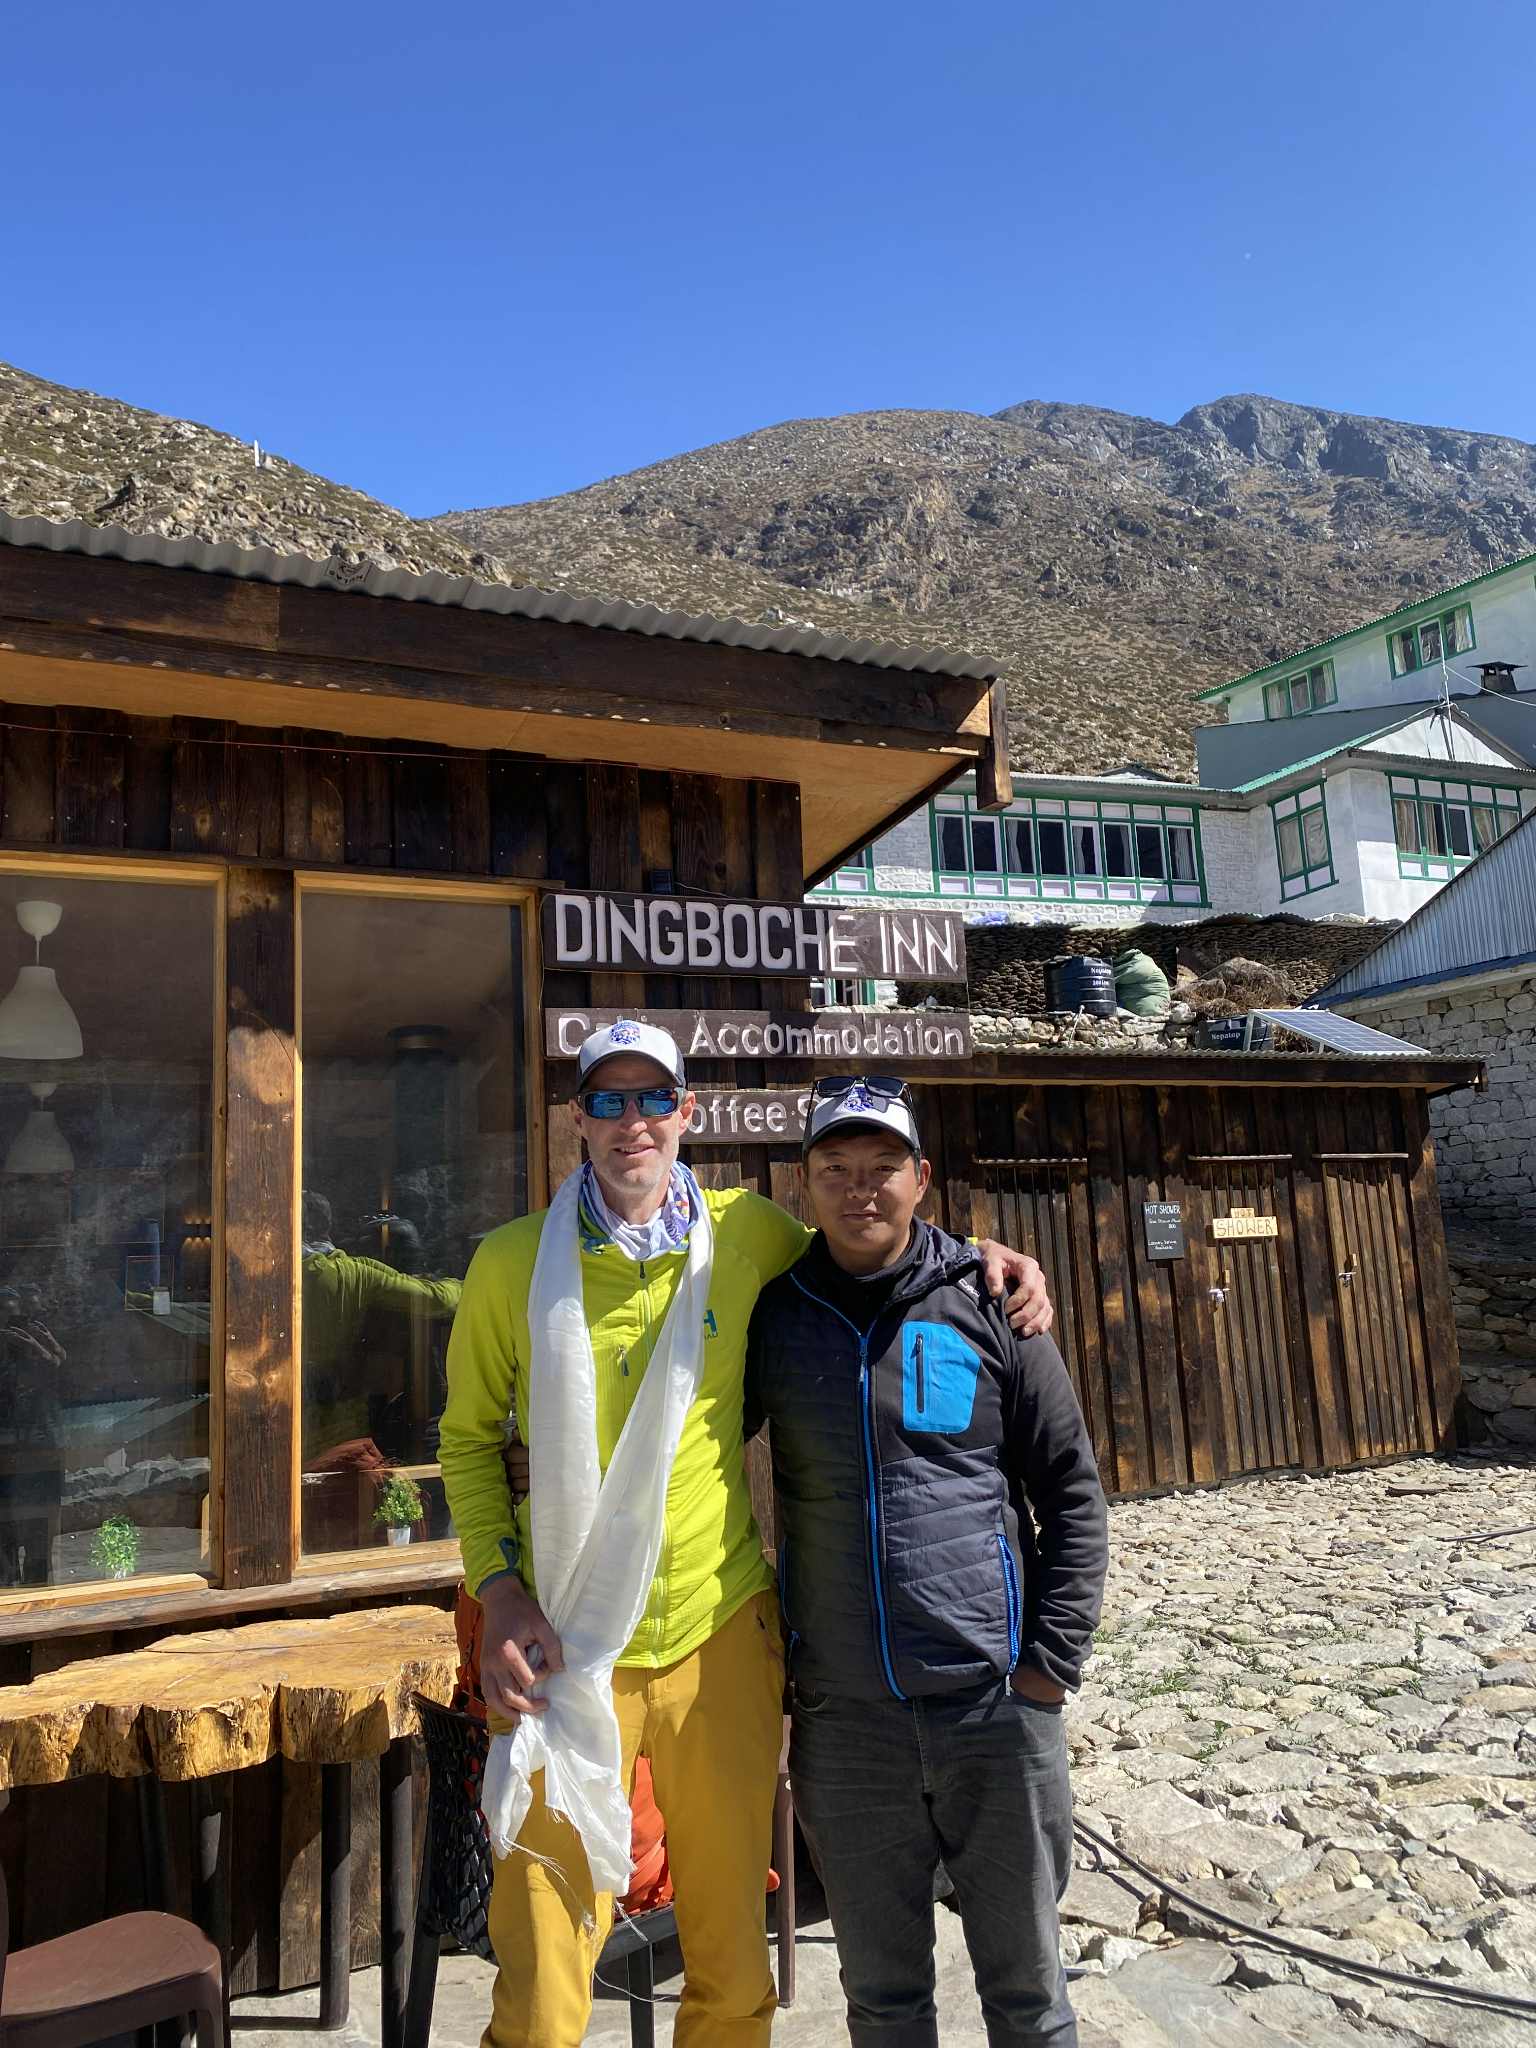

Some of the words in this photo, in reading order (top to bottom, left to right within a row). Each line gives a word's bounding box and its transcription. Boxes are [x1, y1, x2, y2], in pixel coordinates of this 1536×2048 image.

[556, 895, 860, 972] DINGBOCHE
[880, 912, 958, 975] INN
[689, 1016, 964, 1056] Accommodation
[687, 1094, 788, 1134] offee
[1144, 1204, 1158, 1215] HOT
[1159, 1204, 1181, 1214] SHOWER
[1216, 1218, 1273, 1237] SHOWER
